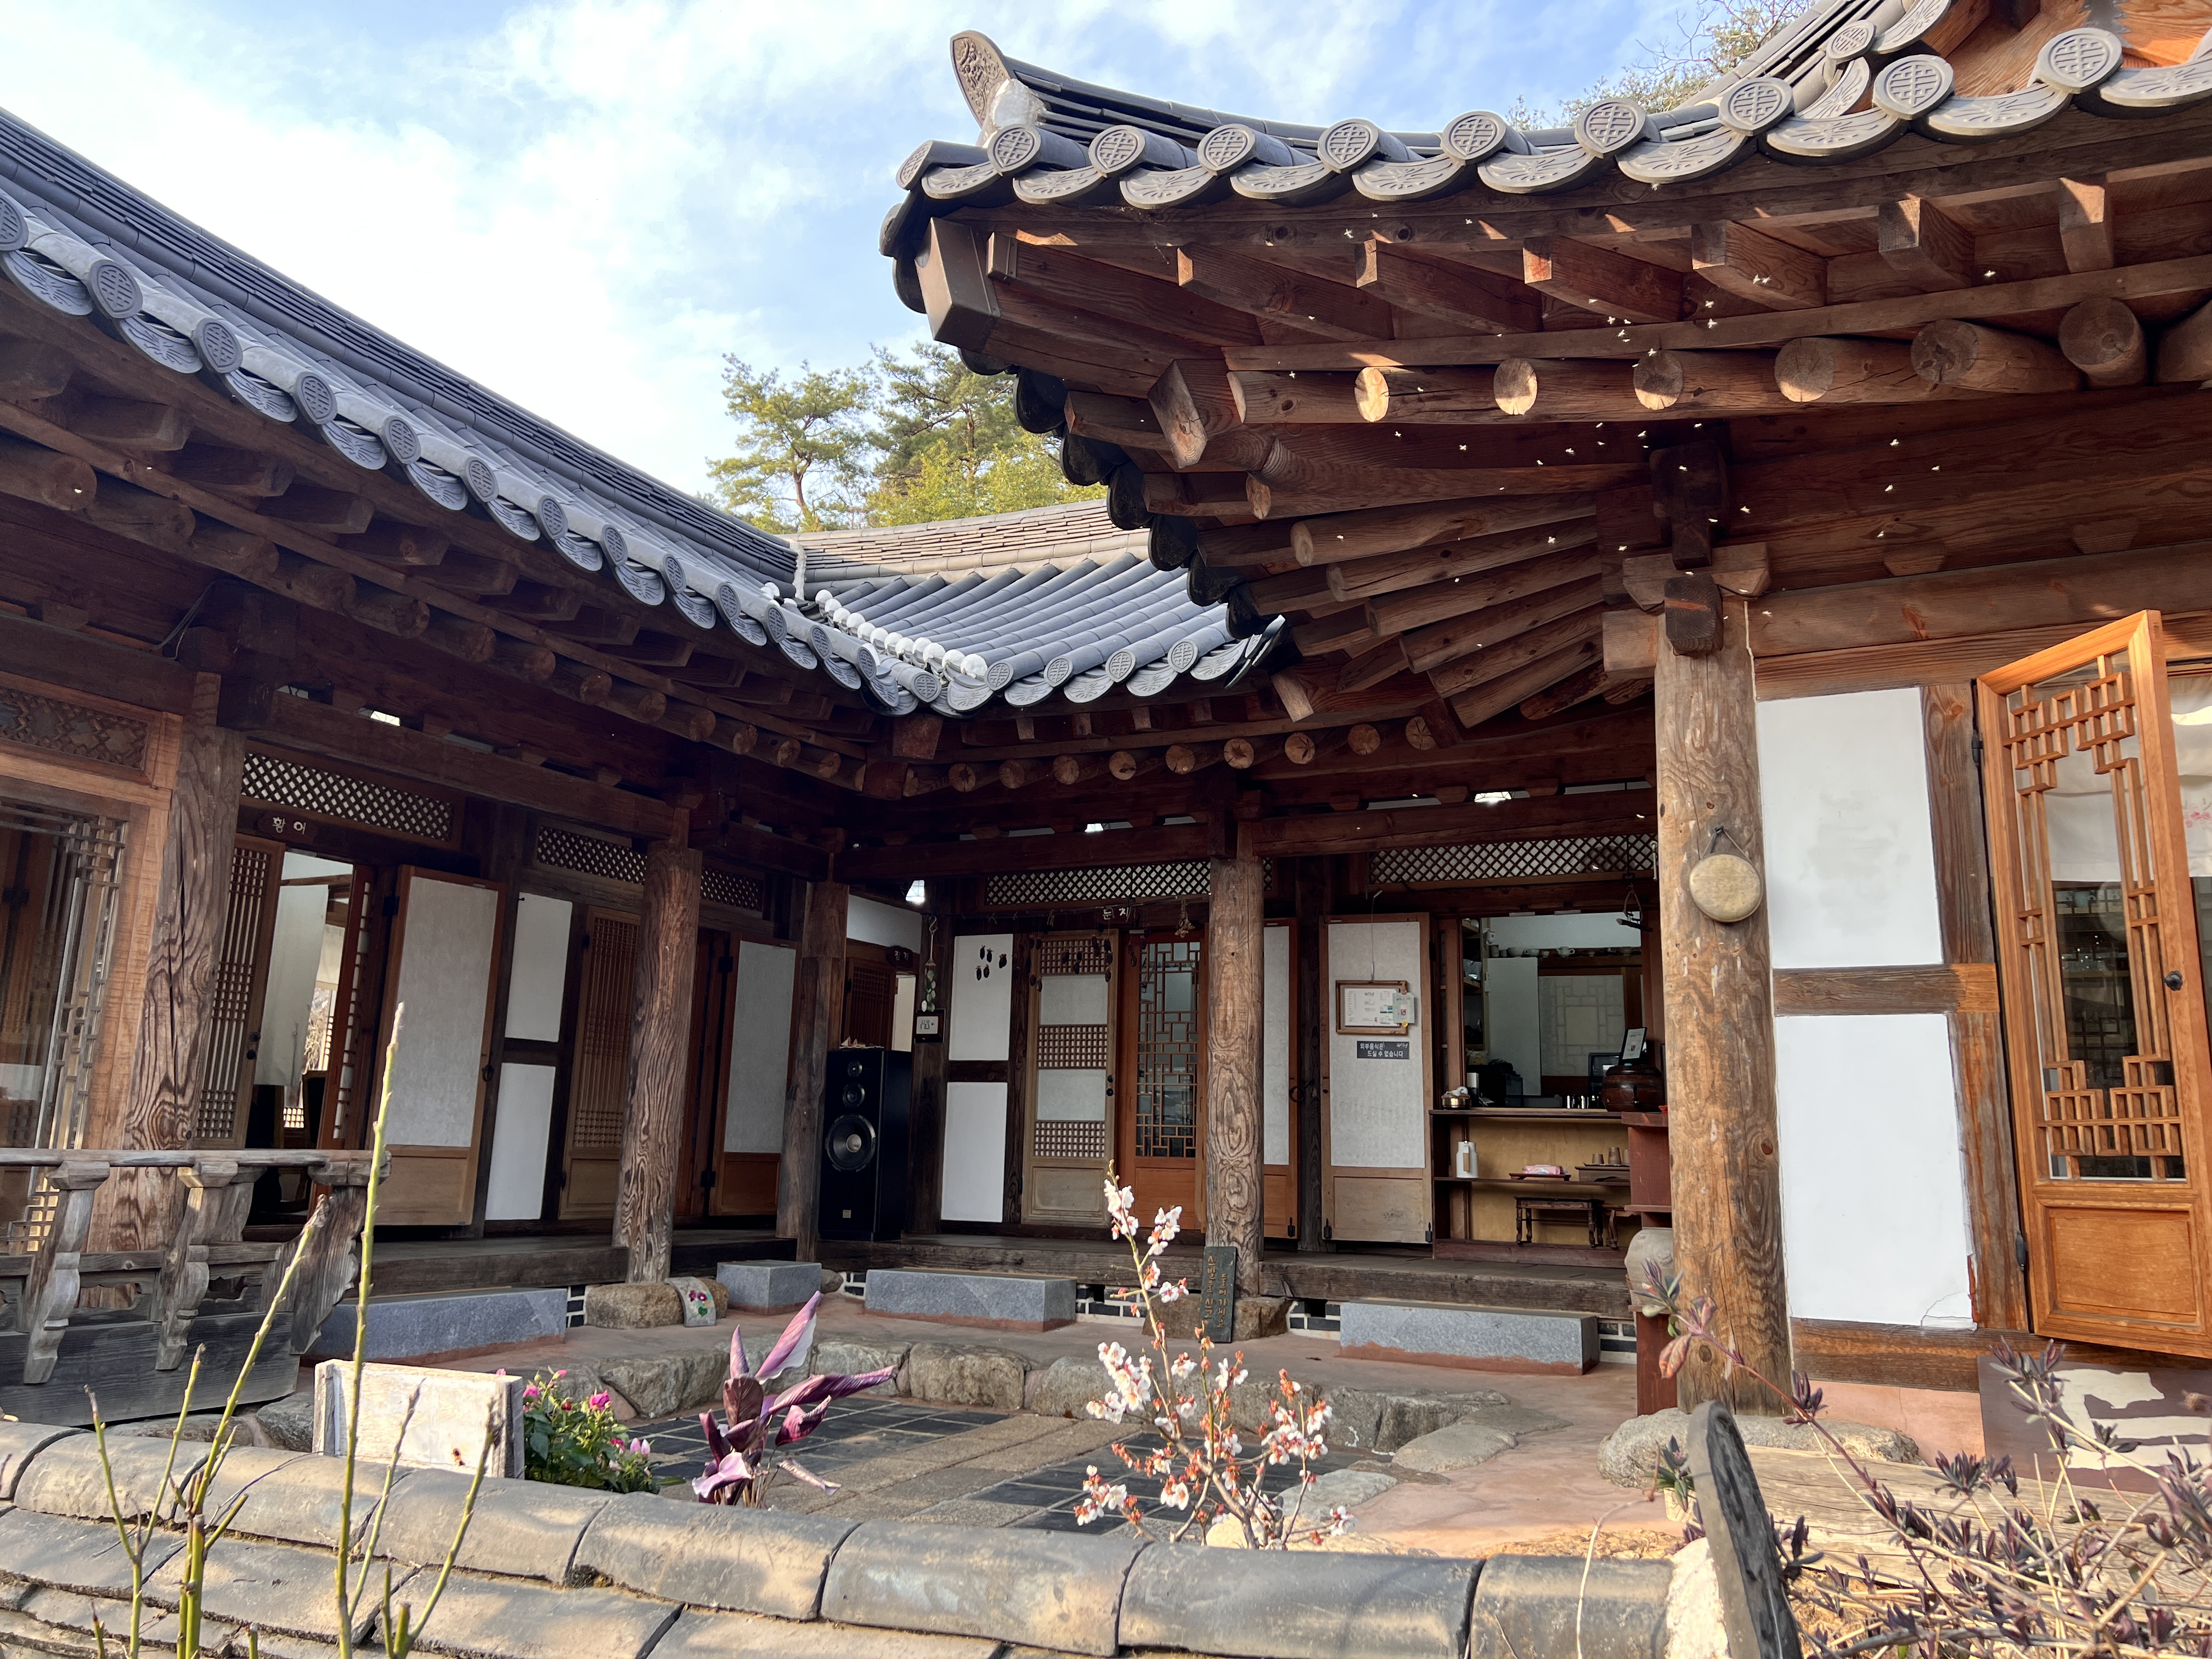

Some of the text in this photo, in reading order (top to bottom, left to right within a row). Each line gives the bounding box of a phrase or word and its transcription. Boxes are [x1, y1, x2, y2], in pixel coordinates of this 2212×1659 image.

[272, 816, 307, 835] 황어
[1204, 1255, 1217, 1318] 신발을 신고
